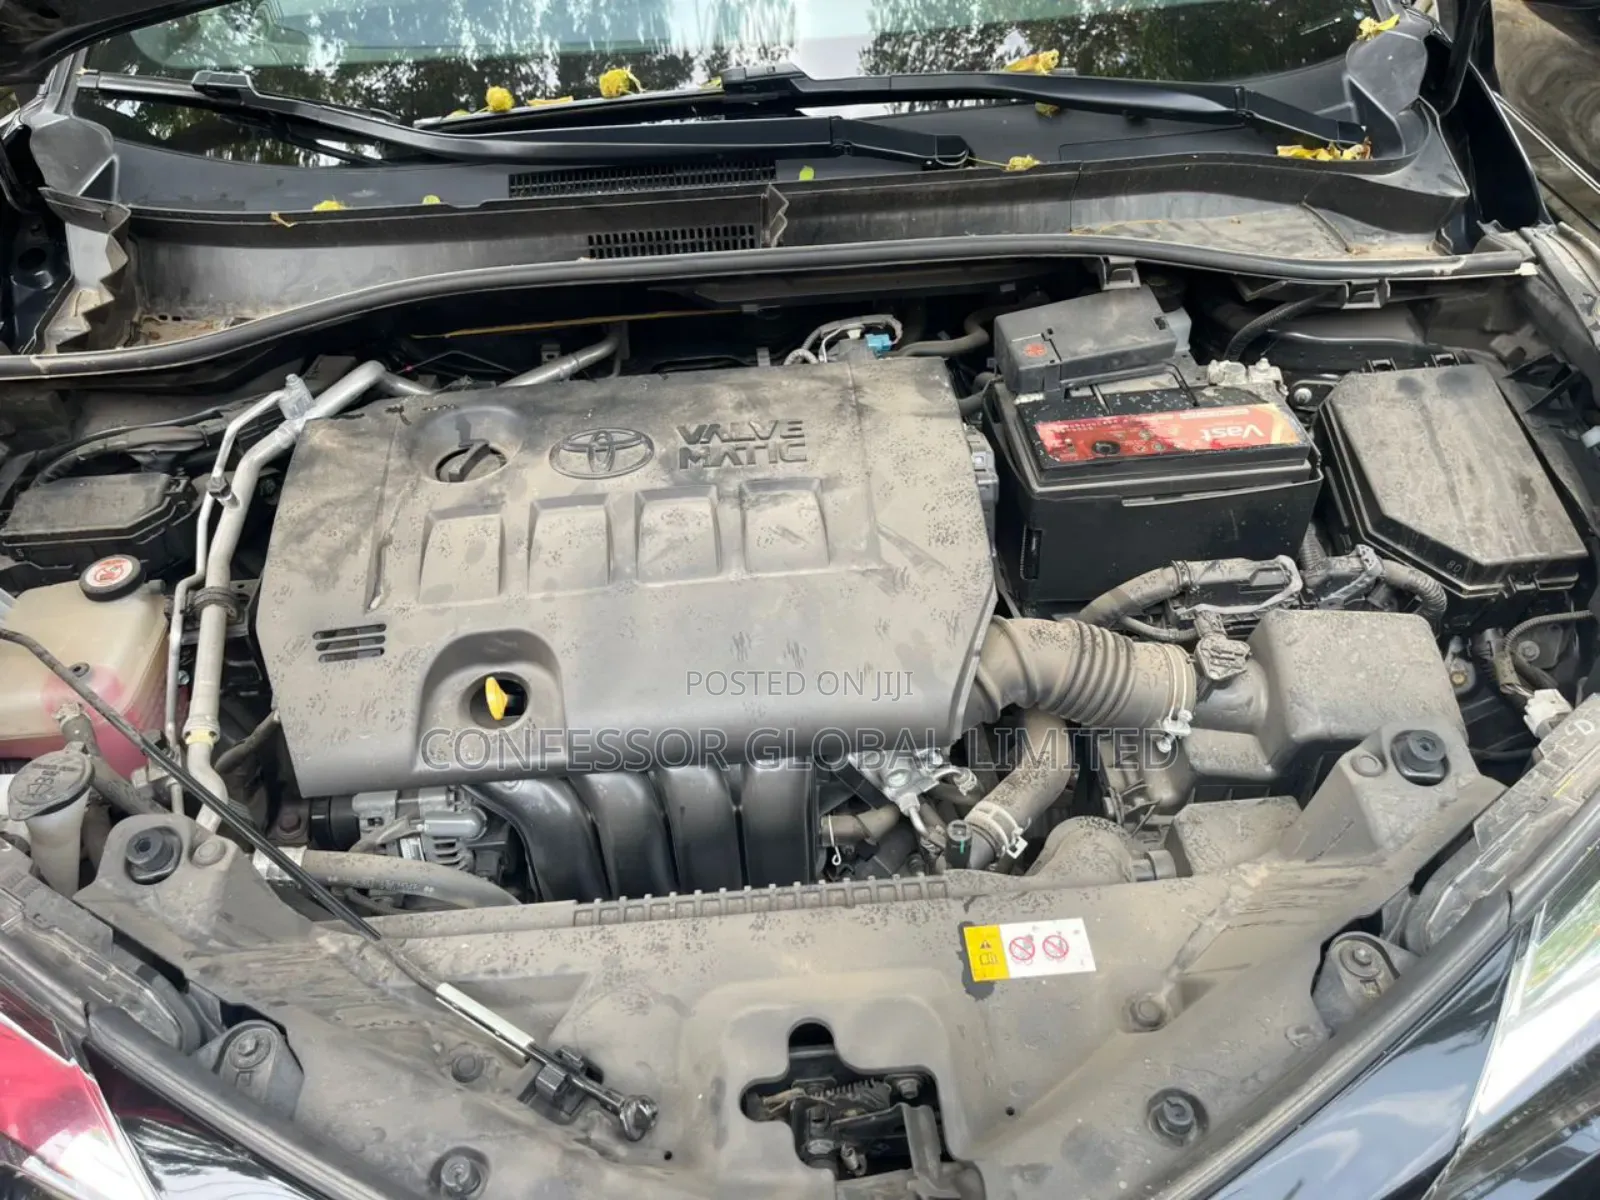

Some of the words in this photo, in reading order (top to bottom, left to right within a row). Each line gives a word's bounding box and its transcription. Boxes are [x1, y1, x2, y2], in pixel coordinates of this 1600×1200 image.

[676, 418, 805, 445] VALVE
[1200, 424, 1265, 442] Vast
[678, 440, 807, 470] MATIC
